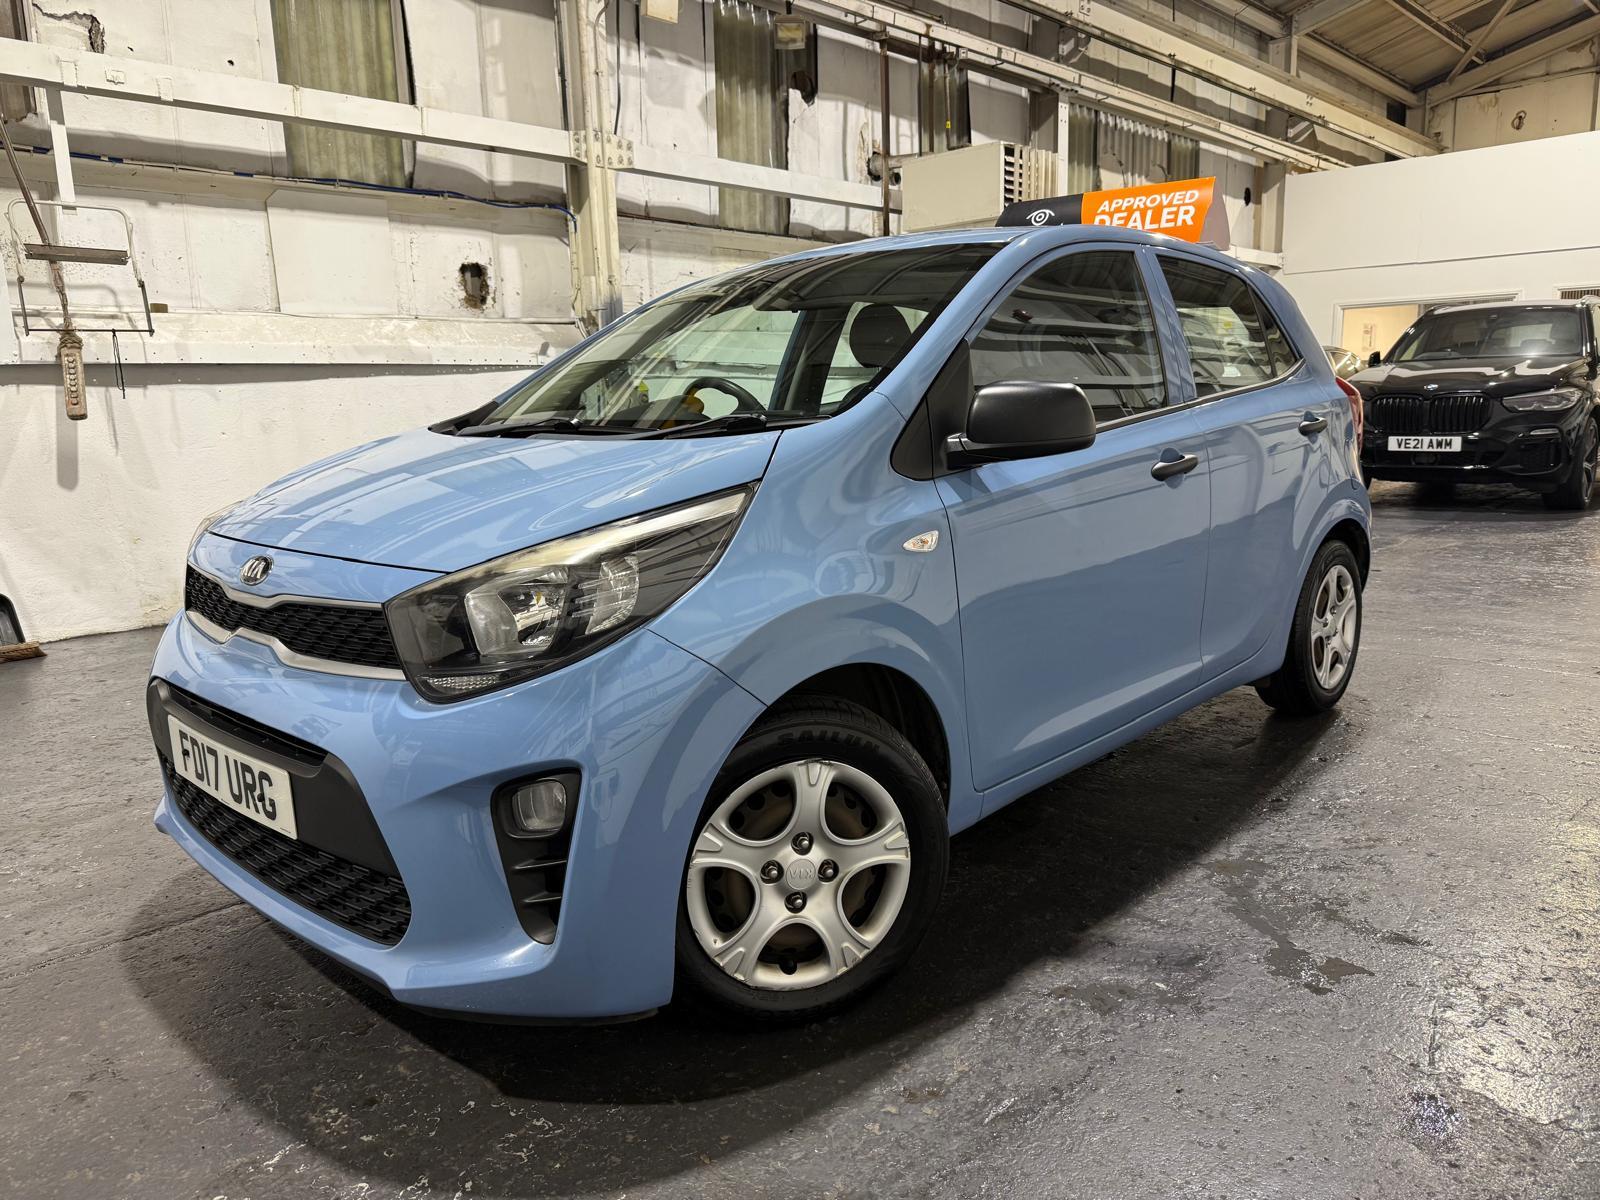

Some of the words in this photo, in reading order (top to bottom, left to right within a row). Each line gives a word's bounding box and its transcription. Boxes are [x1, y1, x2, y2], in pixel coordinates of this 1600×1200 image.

[1097, 190, 1199, 213] APPROVED
[1396, 438, 1423, 449] VE21
[1427, 438, 1452, 449] AWM
[777, 729, 880, 752] SAILUN
[178, 729, 219, 791] FD17
[224, 754, 277, 821] URG
